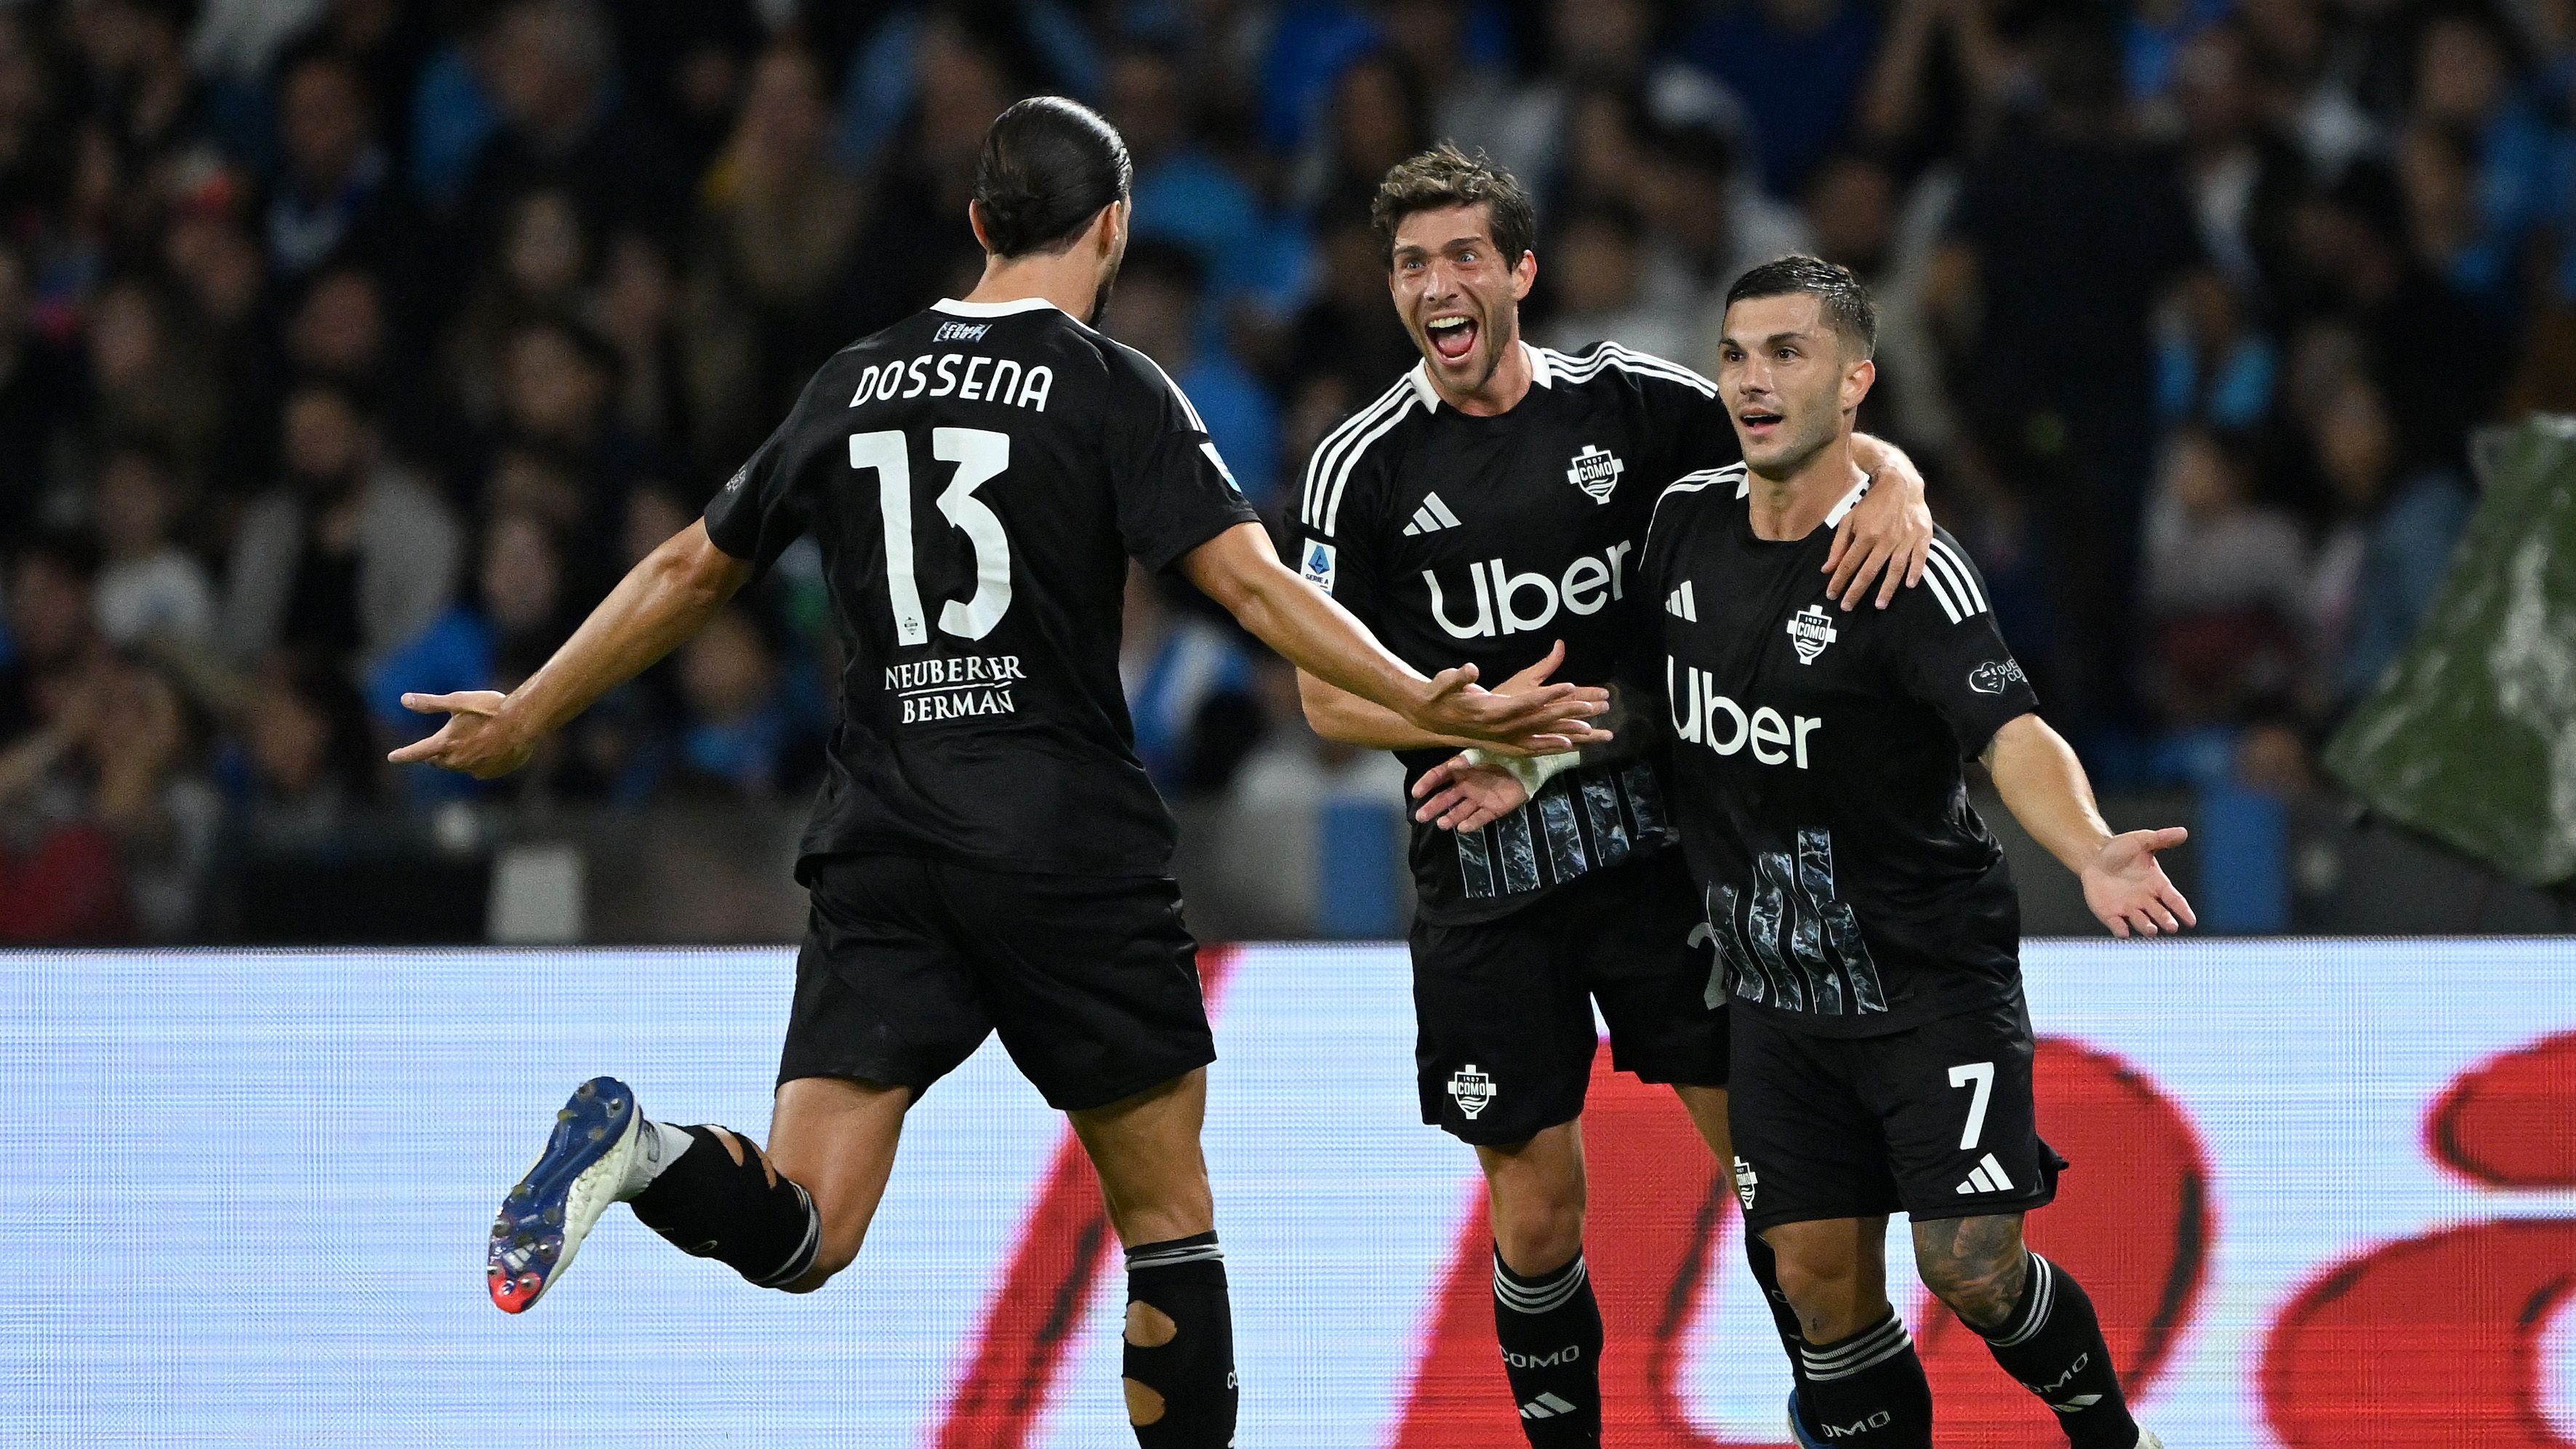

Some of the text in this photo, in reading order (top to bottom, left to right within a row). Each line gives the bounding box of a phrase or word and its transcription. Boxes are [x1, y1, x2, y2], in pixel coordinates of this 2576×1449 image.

[848, 353, 1053, 413] DOSSENA
[1579, 461, 1613, 481] COMO
[1583, 456, 1602, 466] 1907
[848, 427, 1012, 646] 13
[1305, 573, 1323, 584] SERIE
[1421, 539, 1632, 639] Uber
[1797, 622, 1826, 641] COMO
[1805, 616, 1823, 625] 1907
[884, 655, 1027, 691] NEUBERER
[902, 690, 1015, 724] BERMAN
[1668, 654, 1821, 769] Uber
[1458, 1082, 1485, 1096] COMO
[1948, 1061, 1995, 1150] 7
